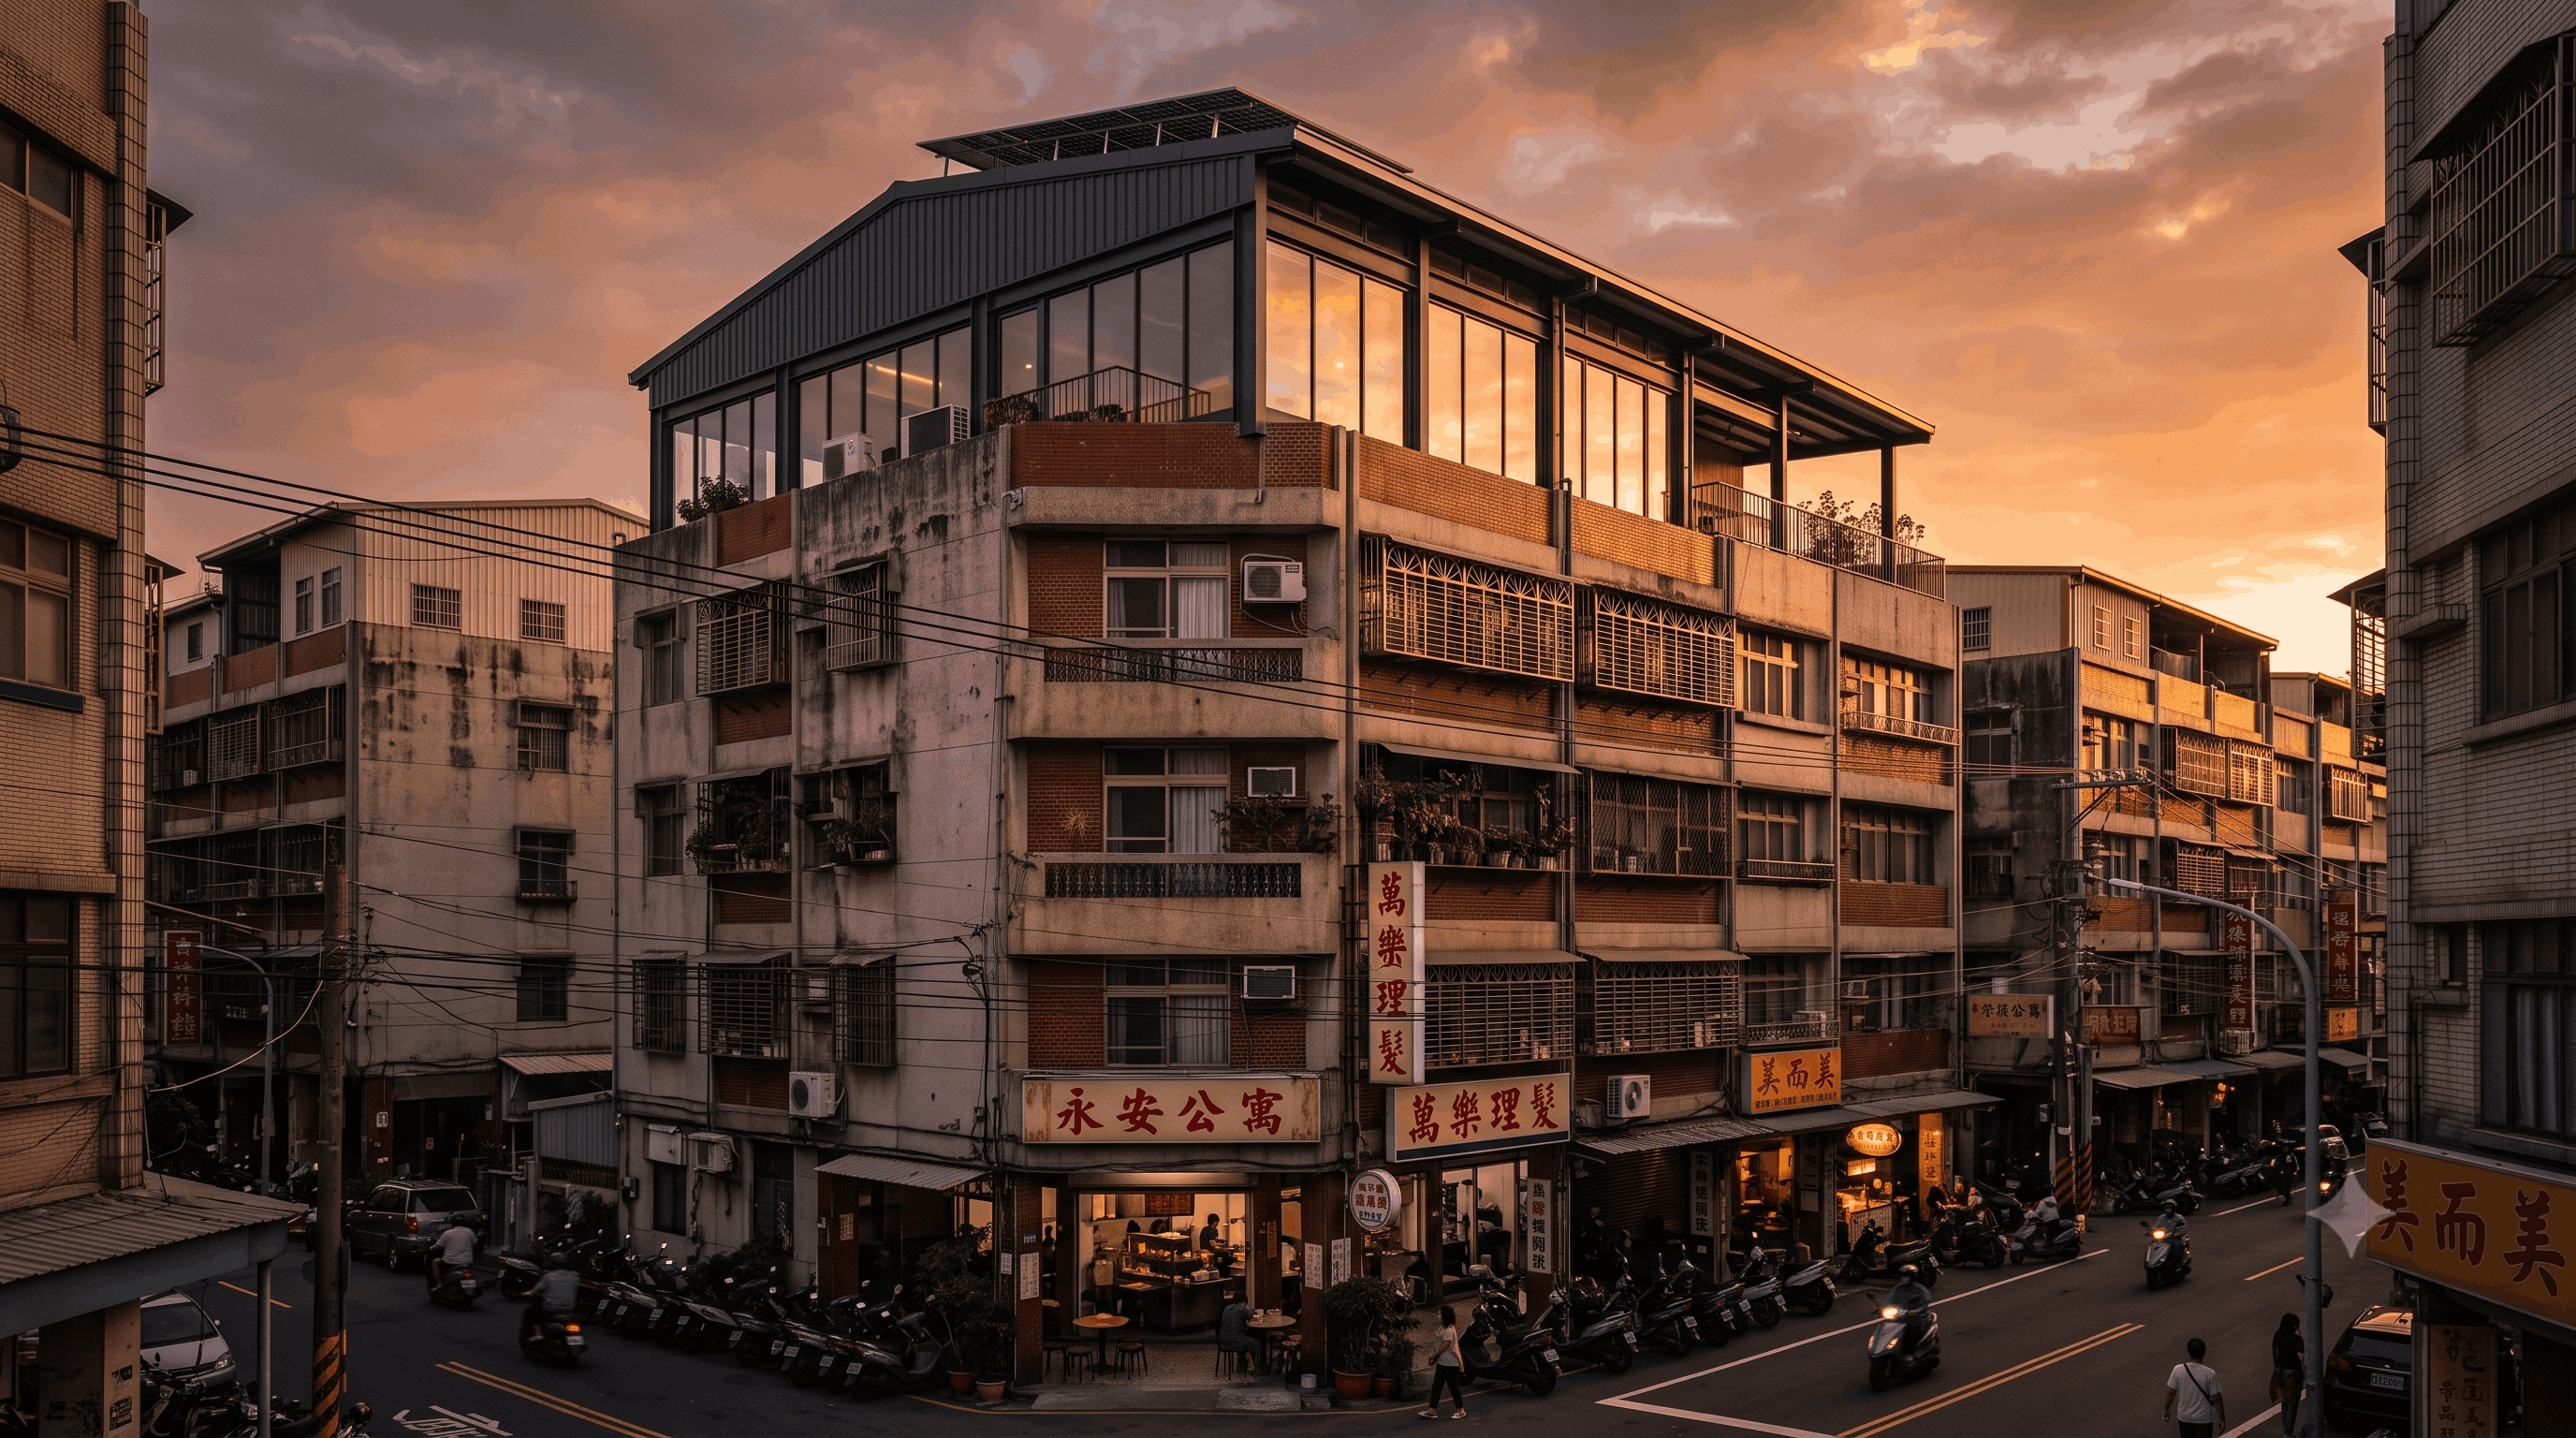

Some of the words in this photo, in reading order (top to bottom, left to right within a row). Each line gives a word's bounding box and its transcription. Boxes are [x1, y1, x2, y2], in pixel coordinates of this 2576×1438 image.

[1377, 872, 1407, 1076] 萬樂理髮
[1057, 1087, 1283, 1136] 永安公寓
[1409, 1082, 1559, 1144] 萬樂理髮
[2375, 1158, 2566, 1299] 美而美
